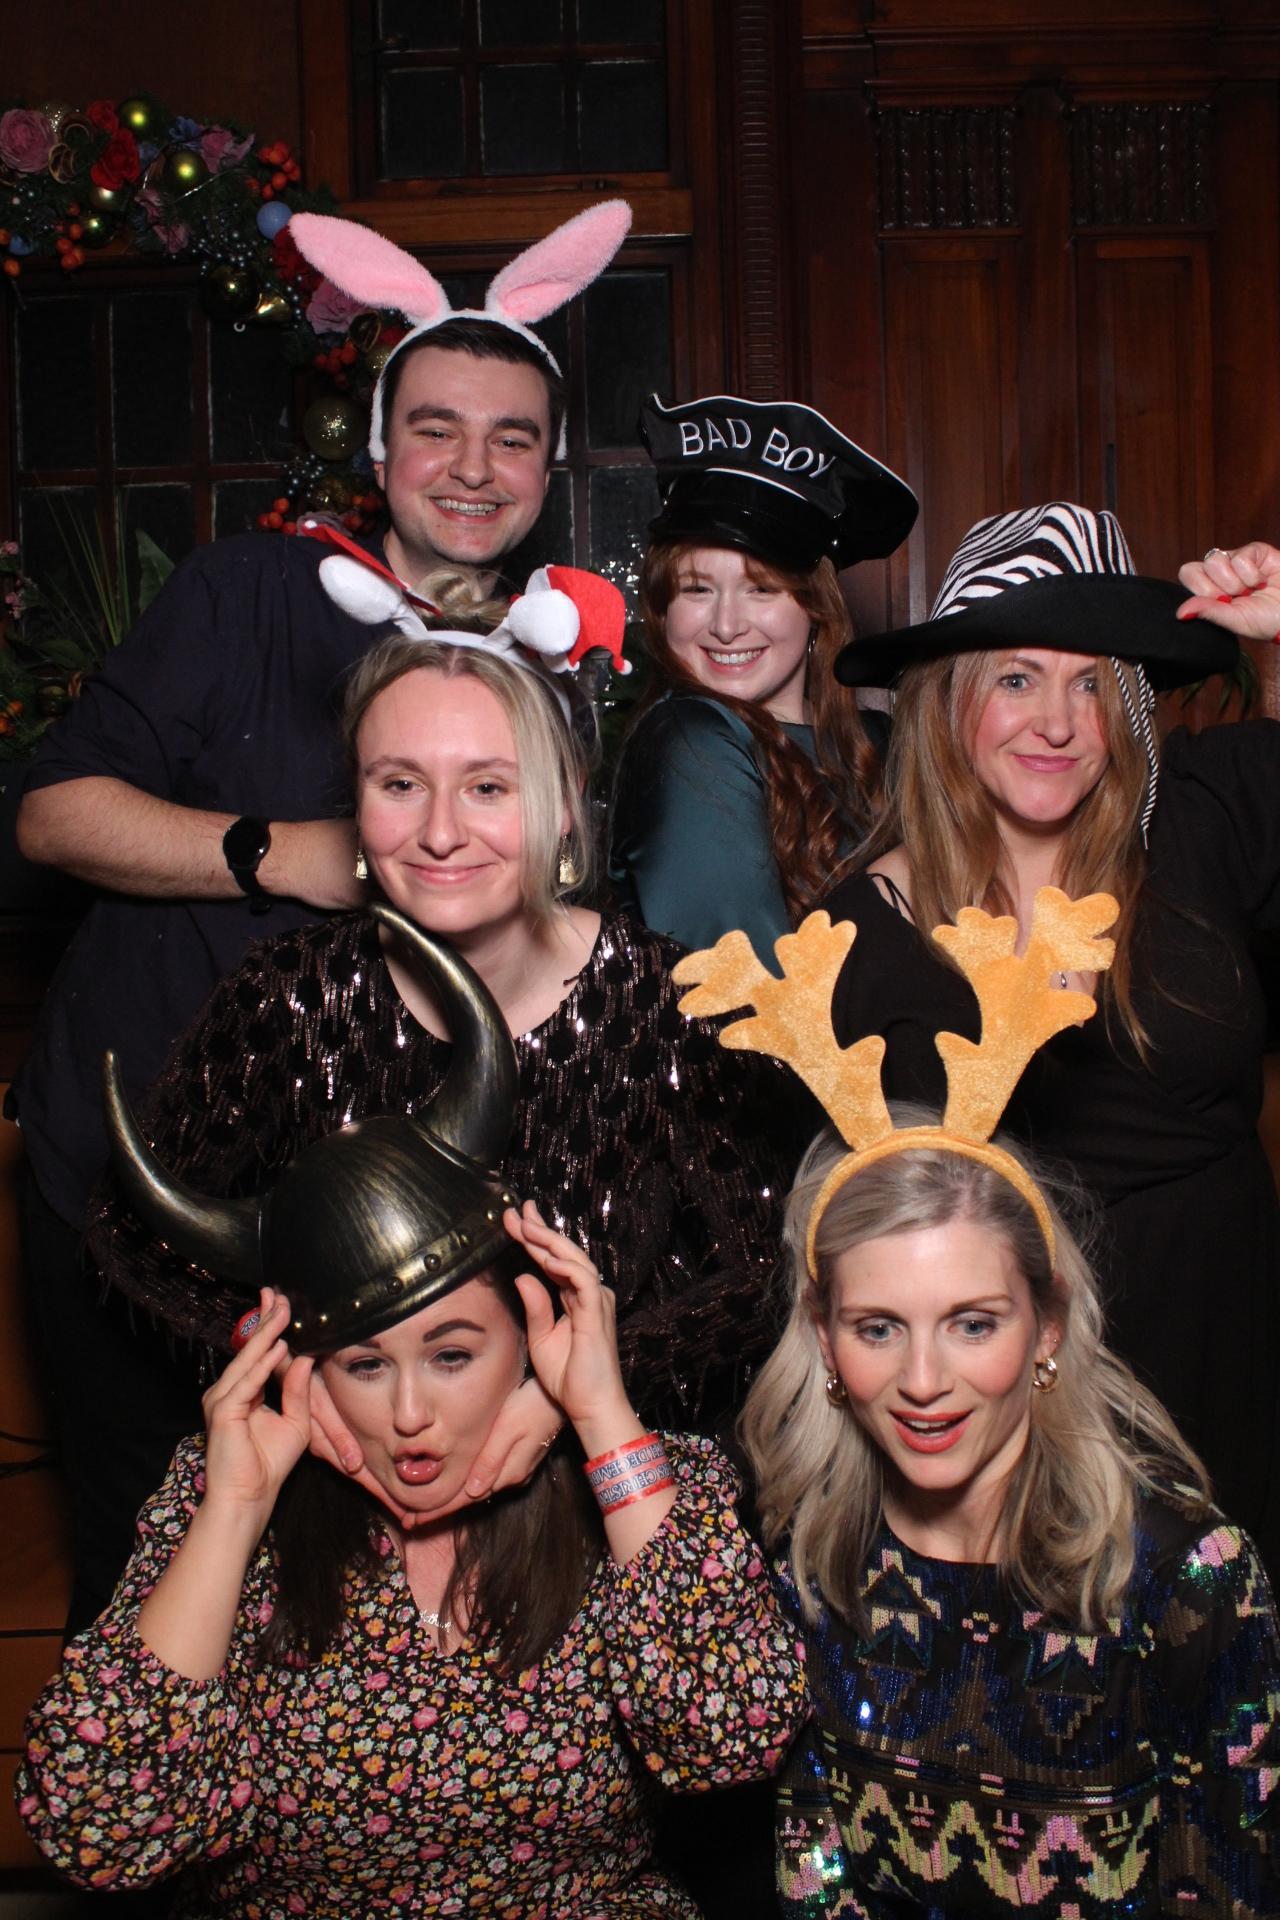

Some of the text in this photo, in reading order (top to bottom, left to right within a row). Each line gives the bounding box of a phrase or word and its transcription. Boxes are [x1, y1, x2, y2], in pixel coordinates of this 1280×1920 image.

[679, 418, 837, 478] BAD BOY
[591, 1446, 651, 1488] DECEMB
